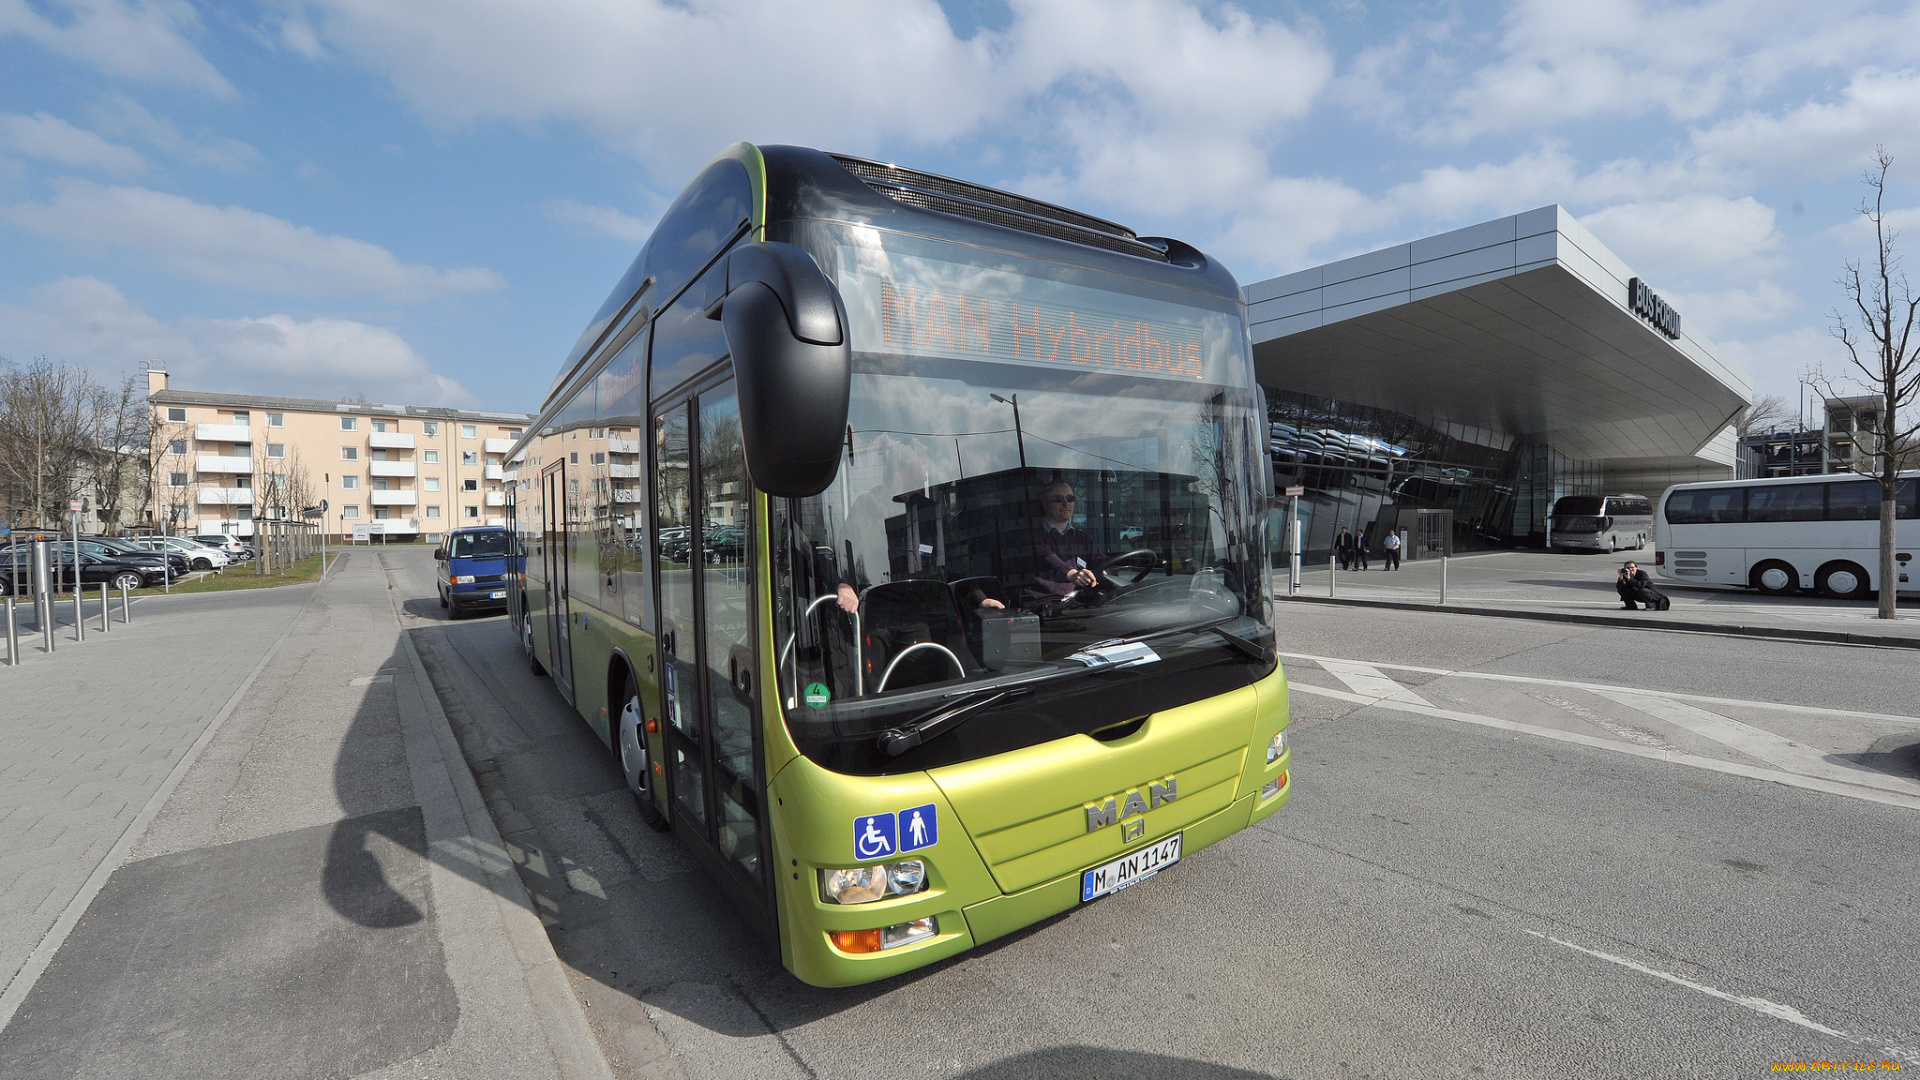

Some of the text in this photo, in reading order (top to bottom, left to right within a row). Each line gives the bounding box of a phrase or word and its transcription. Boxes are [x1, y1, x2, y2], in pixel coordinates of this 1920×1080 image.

[882, 282, 1202, 376] MAN Hybridbus
[1633, 277, 1681, 338] BUS FORUM
[812, 683, 821, 696] 4
[1083, 775, 1178, 833] MAN
[1094, 869, 1107, 892] M
[1117, 856, 1139, 882] AN
[1141, 838, 1179, 872] 1147
